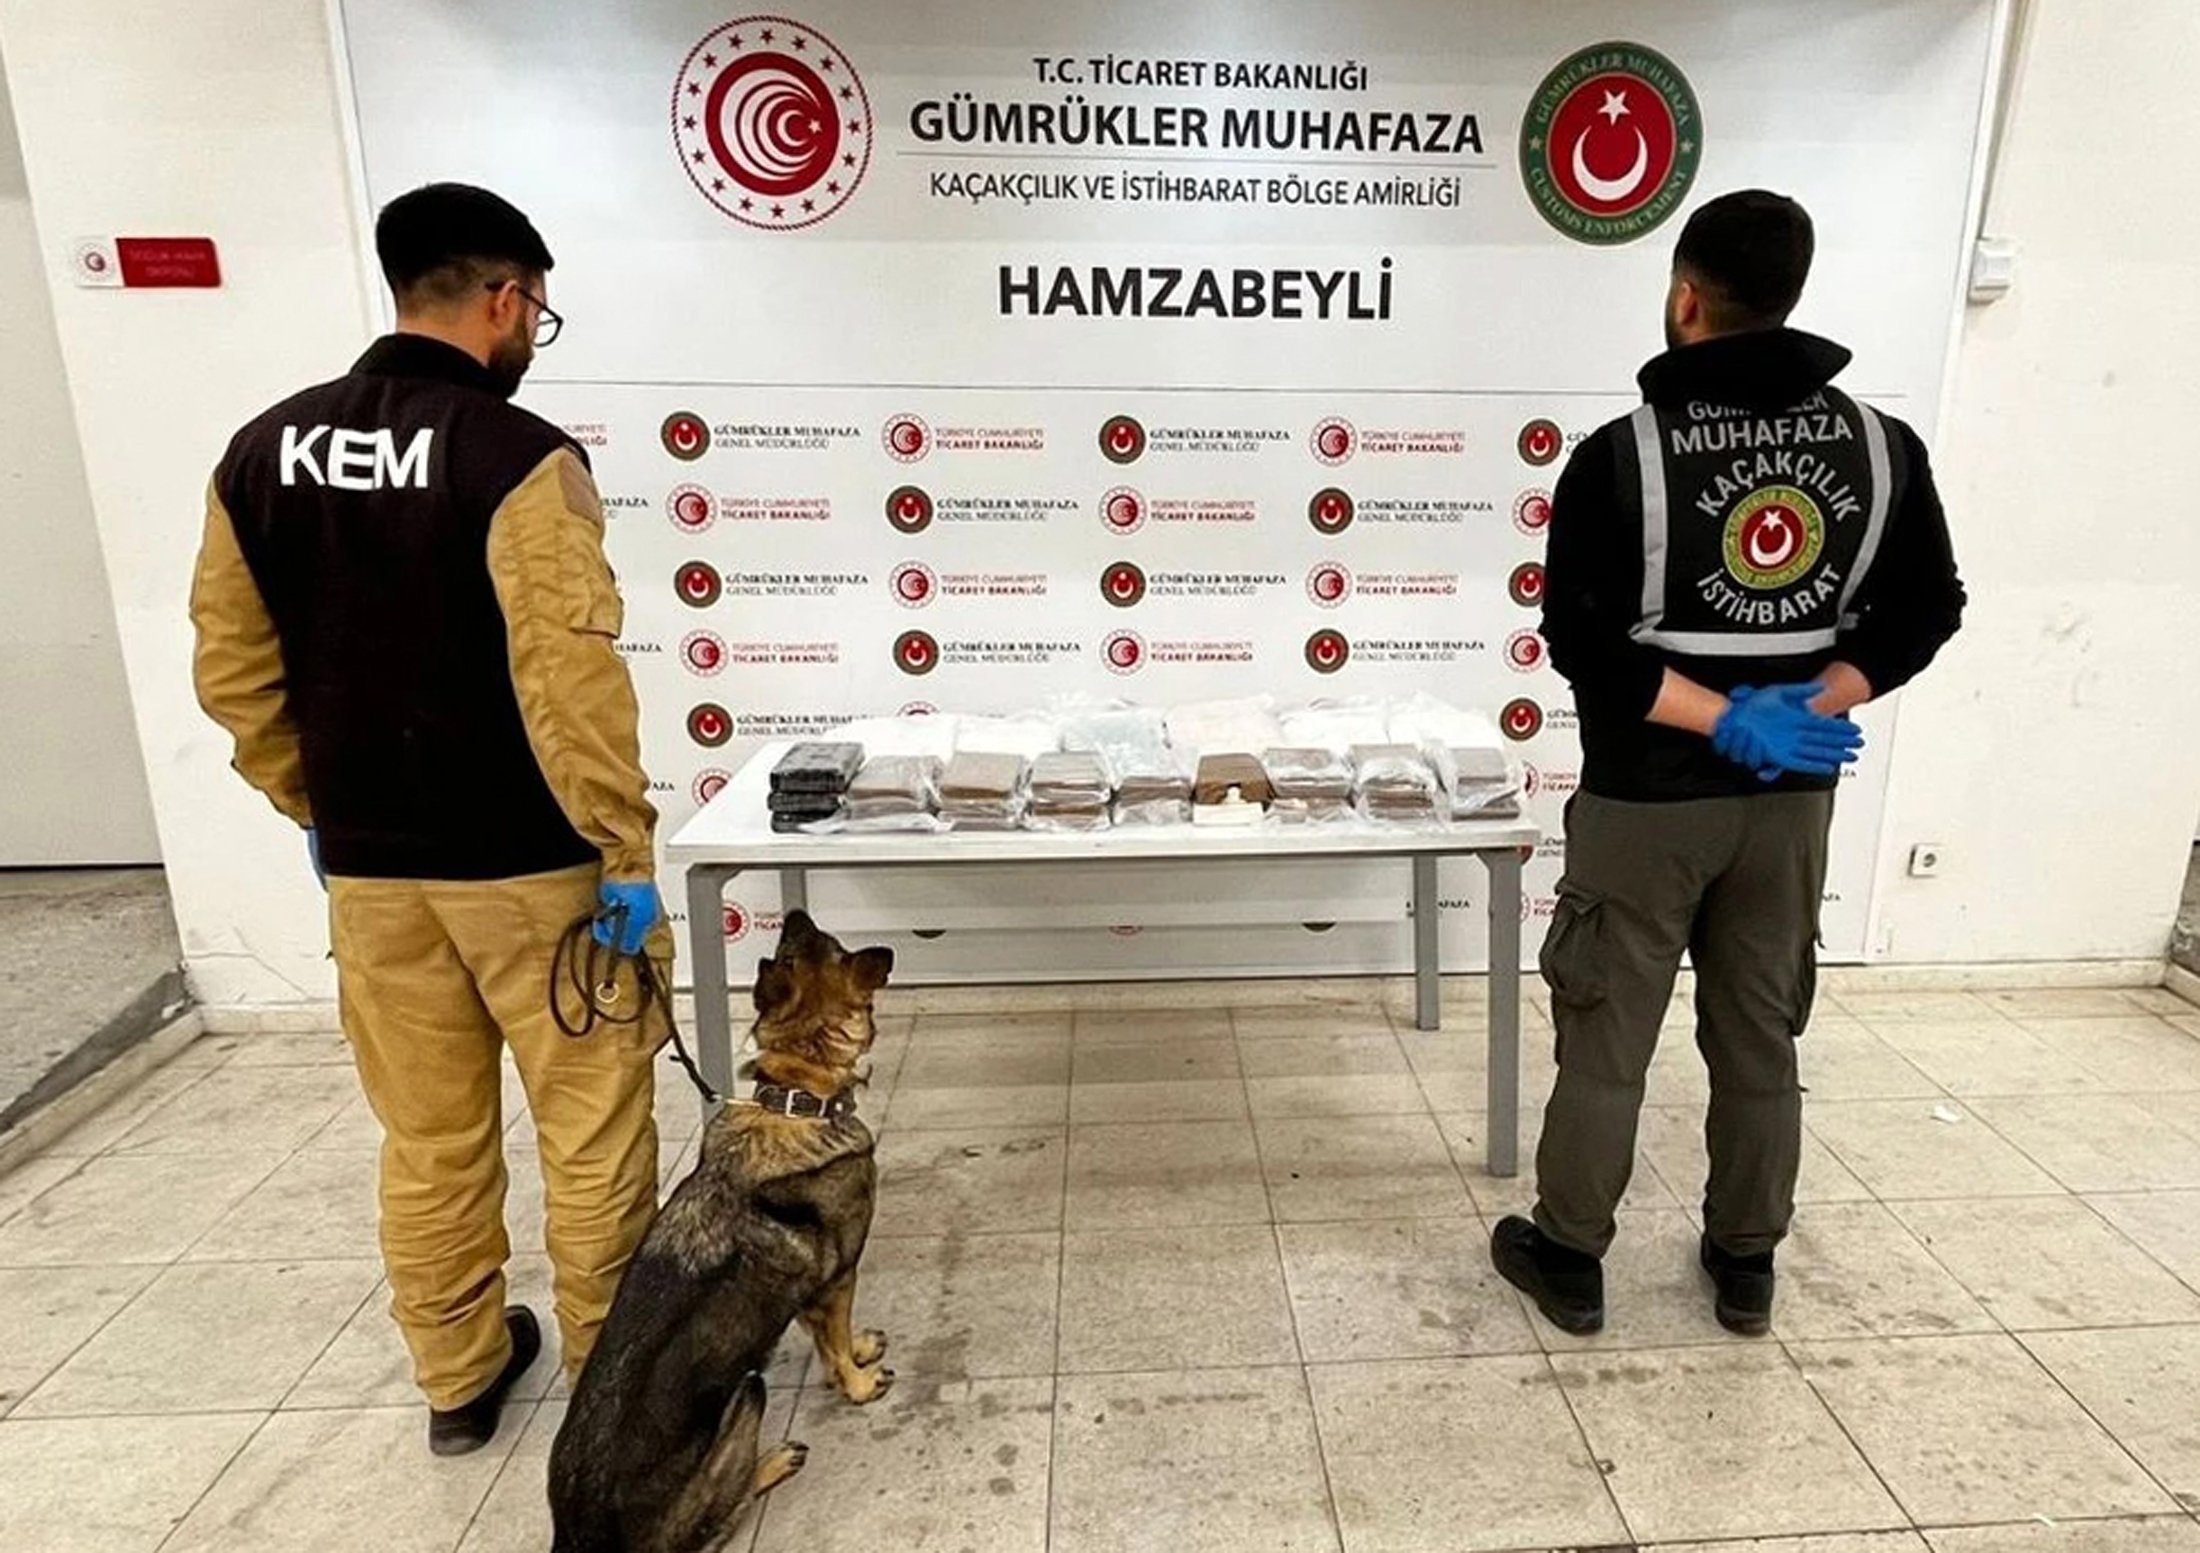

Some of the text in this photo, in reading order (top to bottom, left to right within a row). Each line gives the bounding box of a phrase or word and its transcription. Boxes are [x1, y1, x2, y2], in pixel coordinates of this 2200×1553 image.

[1034, 54, 1367, 91] T.C. TİCARET BAKANLIĞI
[911, 93, 1483, 153] GÜMRÜKLER MUHAFAZA
[931, 170, 1460, 208] KAÇAKÇILIK VE İSTİHBARAT BÖLGE AMİRLİĞİ
[1000, 256, 1392, 320] HAMZABEYLİ
[280, 424, 434, 491] KEM
[1671, 414, 1852, 454] MUHAFAZA
[1696, 450, 1861, 522] KAÇAKÇILIK
[1696, 563, 1841, 625] İSTİHBARAT
